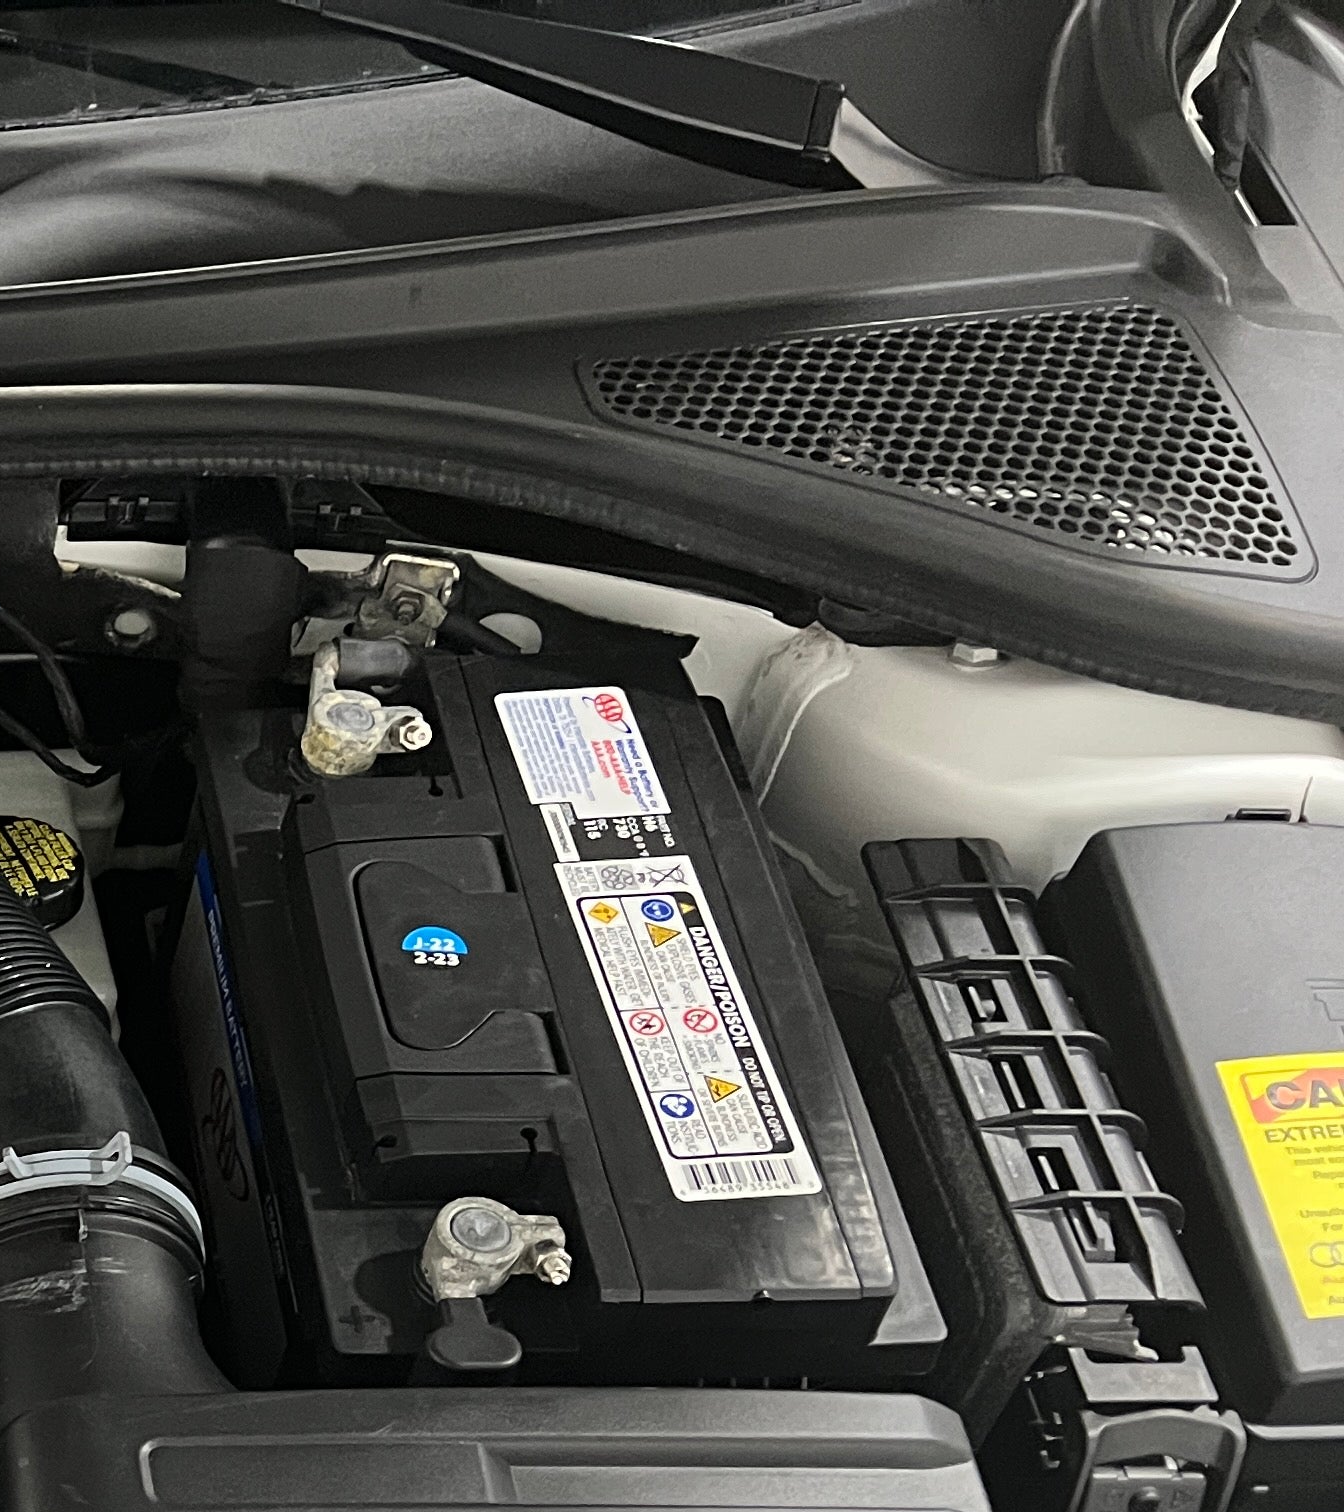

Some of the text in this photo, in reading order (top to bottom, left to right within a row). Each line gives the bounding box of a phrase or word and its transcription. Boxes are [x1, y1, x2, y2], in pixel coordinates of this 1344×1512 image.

[611, 739, 635, 773] Warranty
[635, 769, 657, 797] Battery
[581, 820, 602, 839] 115
[610, 817, 632, 839] 730
[206, 908, 230, 998] PREMIUM
[413, 951, 459, 966] 2-23
[686, 925, 752, 1047] DANGER/POISON
[746, 1071, 764, 1088] NOT
[1266, 1079, 1344, 1111] CA
